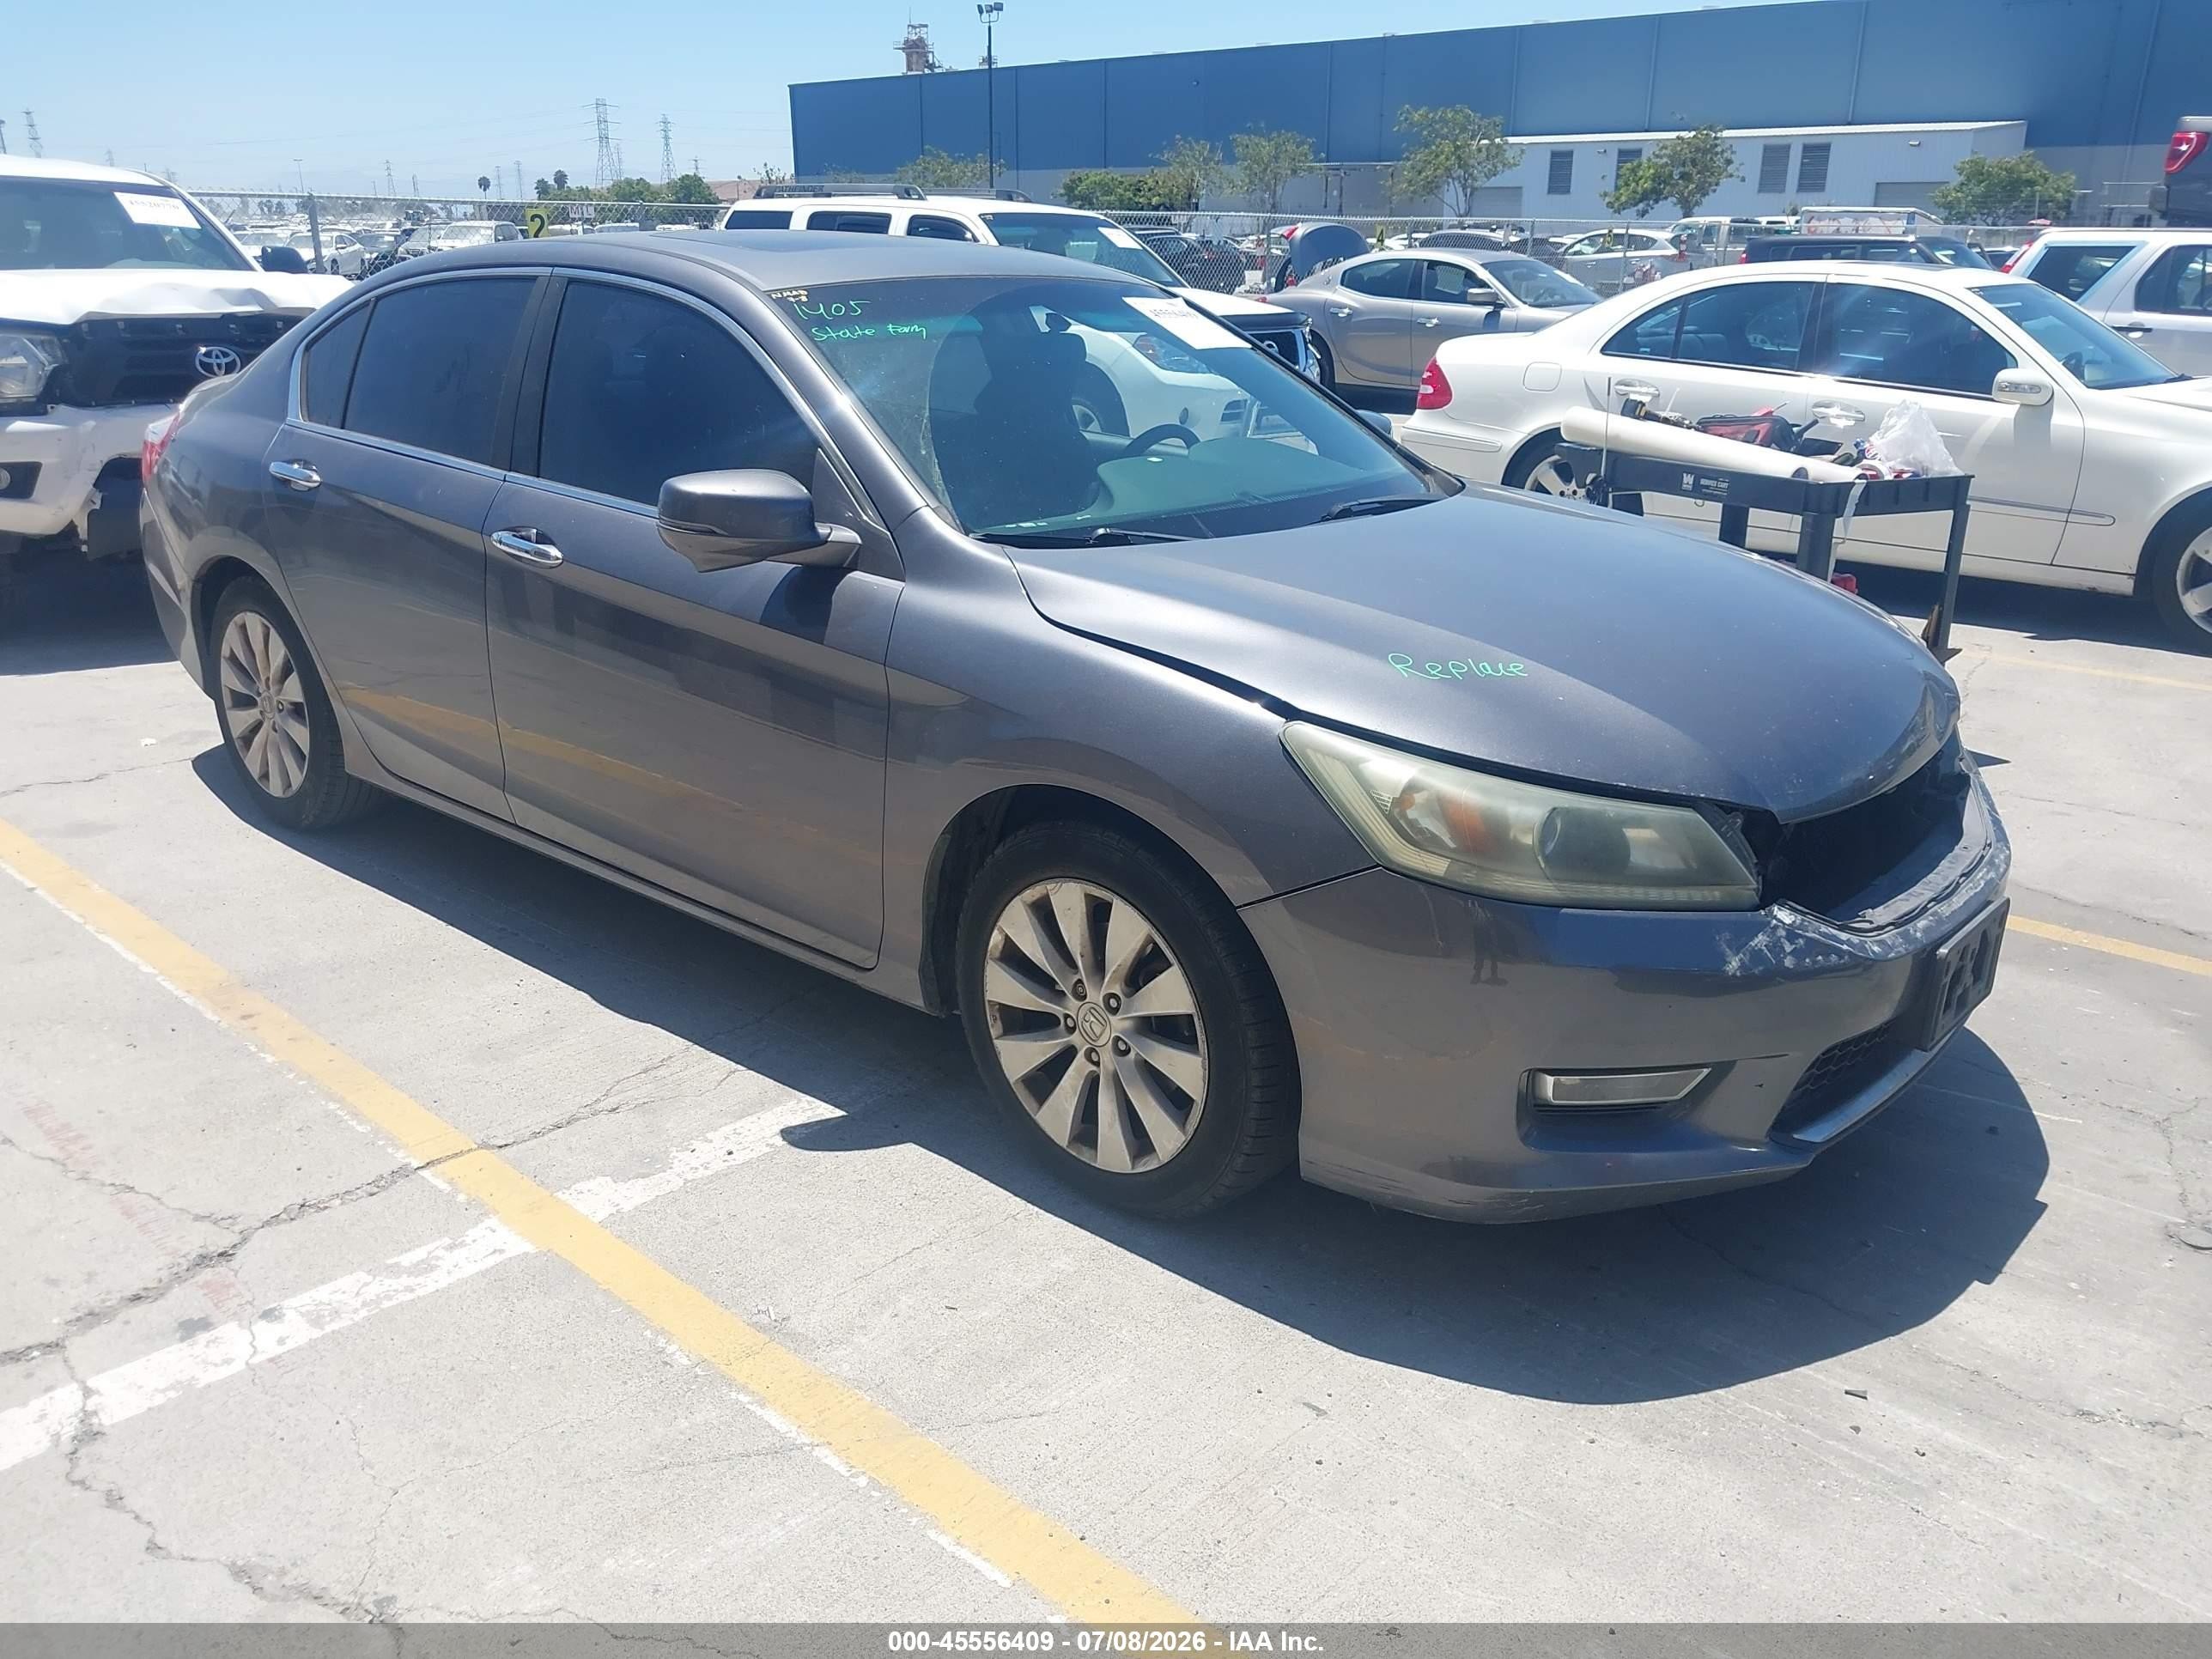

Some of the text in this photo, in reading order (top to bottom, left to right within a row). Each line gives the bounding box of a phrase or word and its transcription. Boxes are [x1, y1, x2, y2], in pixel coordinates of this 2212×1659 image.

[530, 213, 544, 238] 2
[1376, 228, 1385, 246] 4
[811, 325, 876, 341] State
